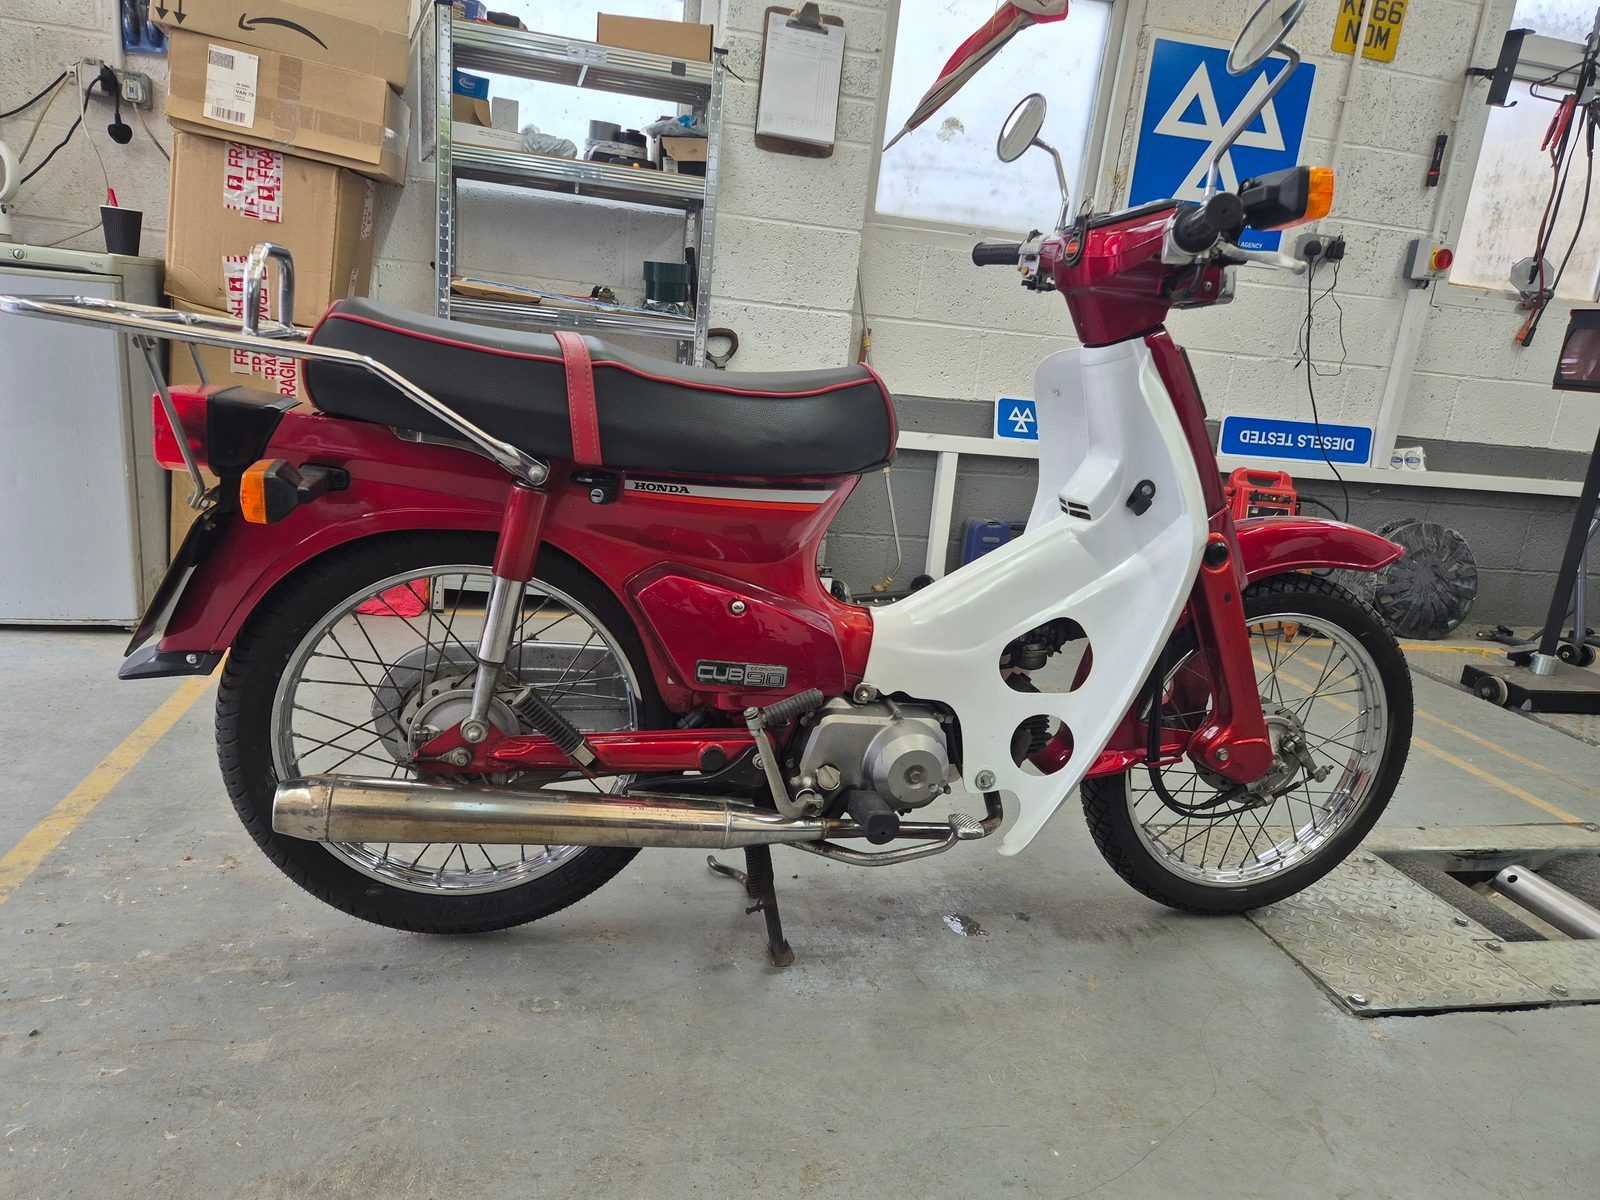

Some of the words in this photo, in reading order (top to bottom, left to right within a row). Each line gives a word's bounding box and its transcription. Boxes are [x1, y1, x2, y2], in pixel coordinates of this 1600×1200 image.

[1240, 241, 1263, 249] AGENCY
[1239, 429, 1294, 447] TESTED
[1297, 434, 1355, 451] DIESELS
[634, 481, 690, 494] HONDA
[697, 665, 745, 681] CUB
